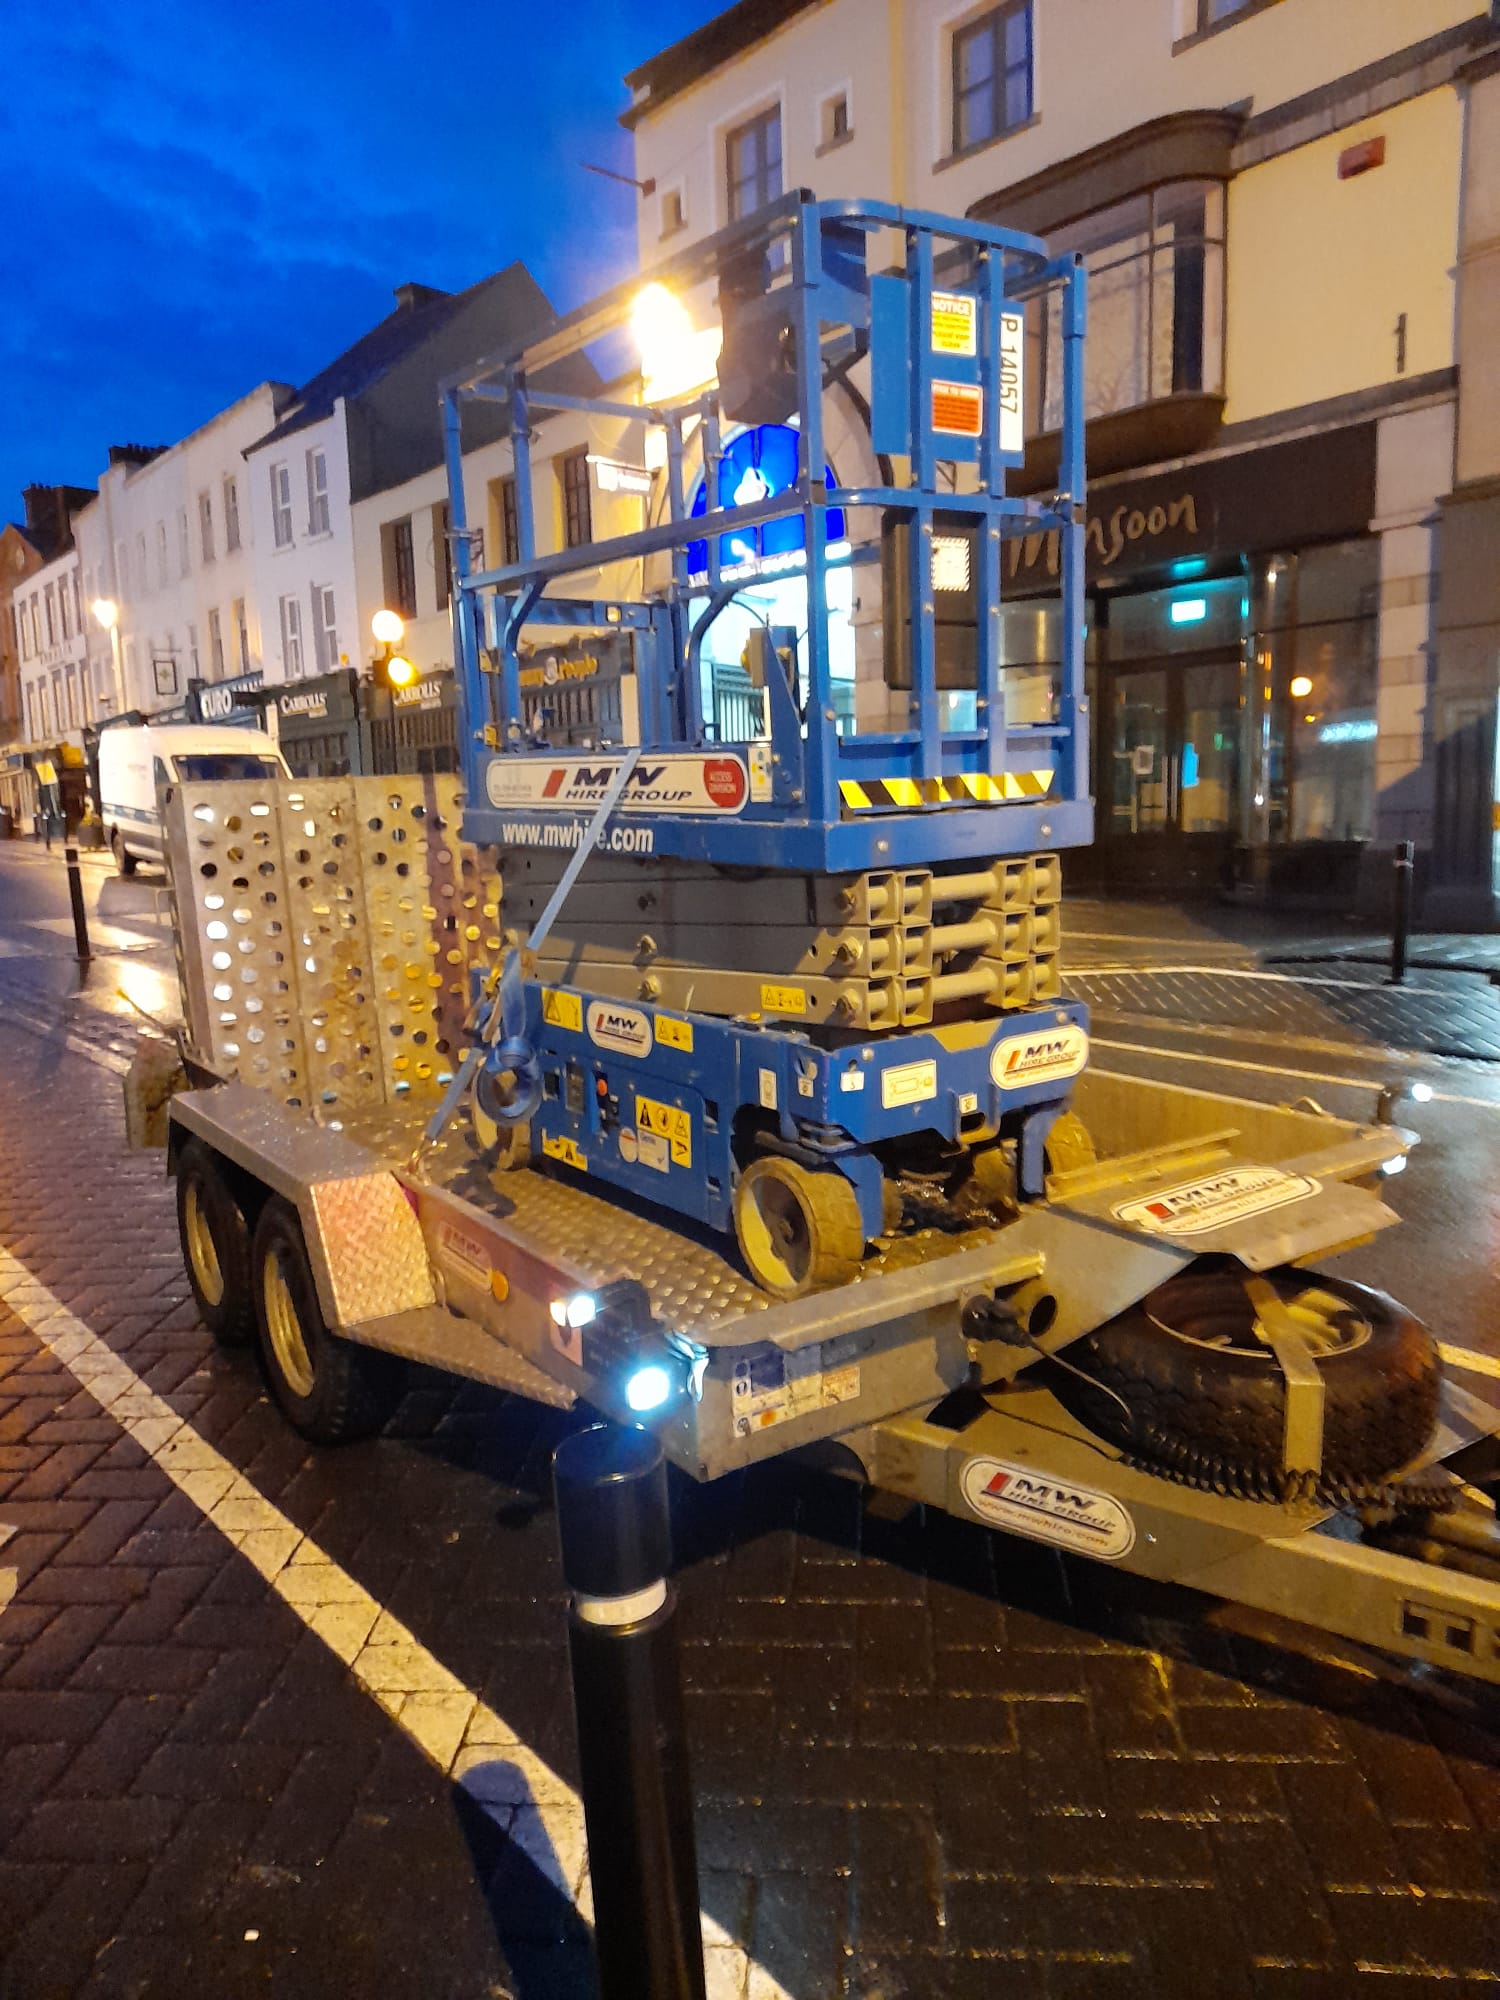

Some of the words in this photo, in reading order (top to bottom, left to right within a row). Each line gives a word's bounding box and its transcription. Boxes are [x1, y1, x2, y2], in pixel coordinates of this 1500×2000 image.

[1001, 318, 1018, 333] P
[1000, 345, 1018, 414] 14057
[1009, 494, 1198, 577] Mnsoon
[619, 790, 692, 801] GROUP
[502, 819, 654, 852] www.mwhie.com
[607, 1015, 637, 1030] MW
[1025, 1040, 1070, 1058] MW
[1168, 1177, 1239, 1205] MW
[1015, 1479, 1097, 1509] MW
[1008, 1491, 1049, 1507] HIRE
[1053, 1505, 1117, 1528] GROUP
